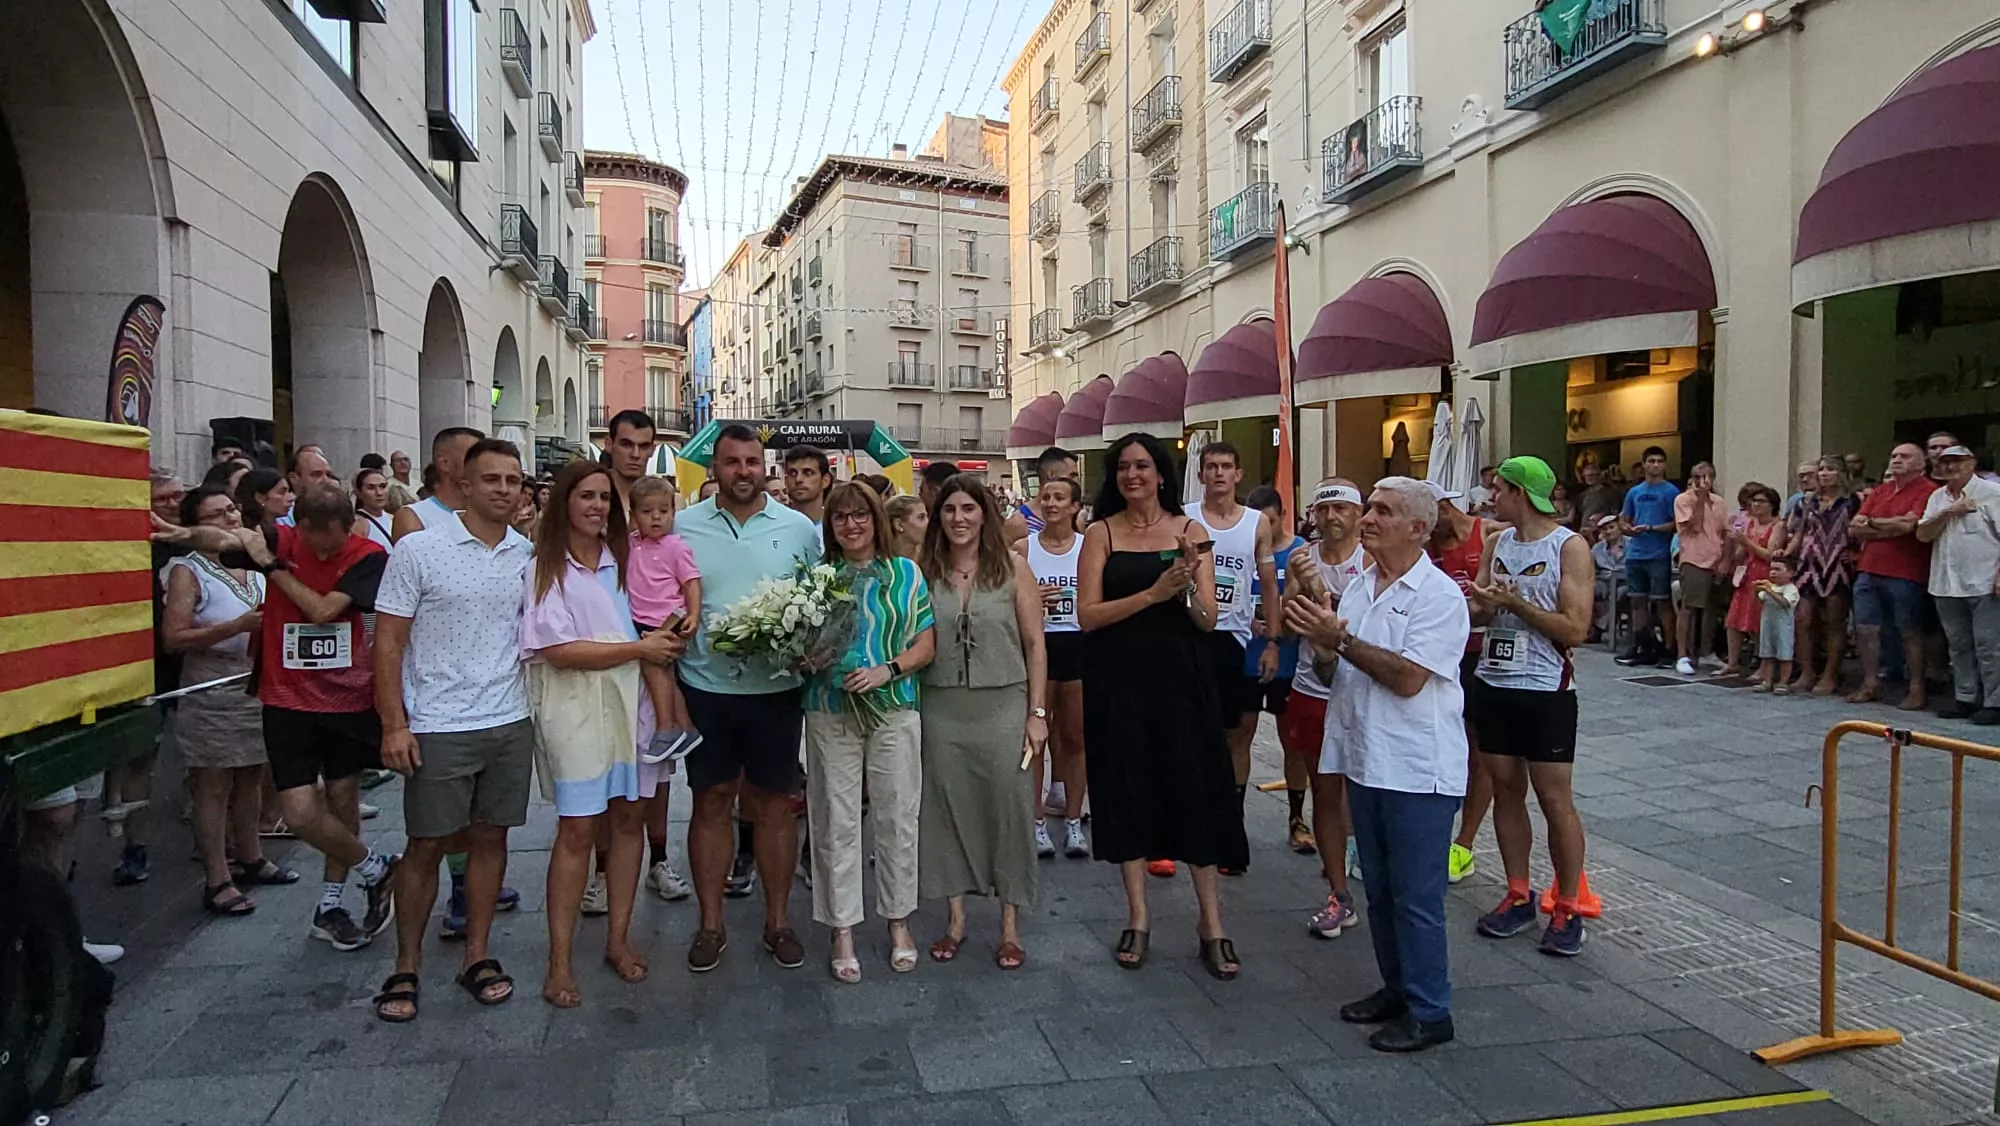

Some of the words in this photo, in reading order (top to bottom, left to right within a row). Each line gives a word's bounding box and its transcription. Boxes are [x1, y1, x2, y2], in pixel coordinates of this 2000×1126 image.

[995, 320, 1006, 386] HOSTAL
[780, 425, 806, 435] CAJA
[808, 425, 843, 435] RURAL
[787, 436, 798, 444] DE
[800, 434, 837, 444] ARAGÓN
[1215, 554, 1245, 570] BES
[1037, 575, 1078, 587] ARBE
[1215, 586, 1233, 601] 57
[1056, 600, 1072, 613] 49
[311, 639, 335, 656] 60
[1495, 642, 1513, 658] 65
